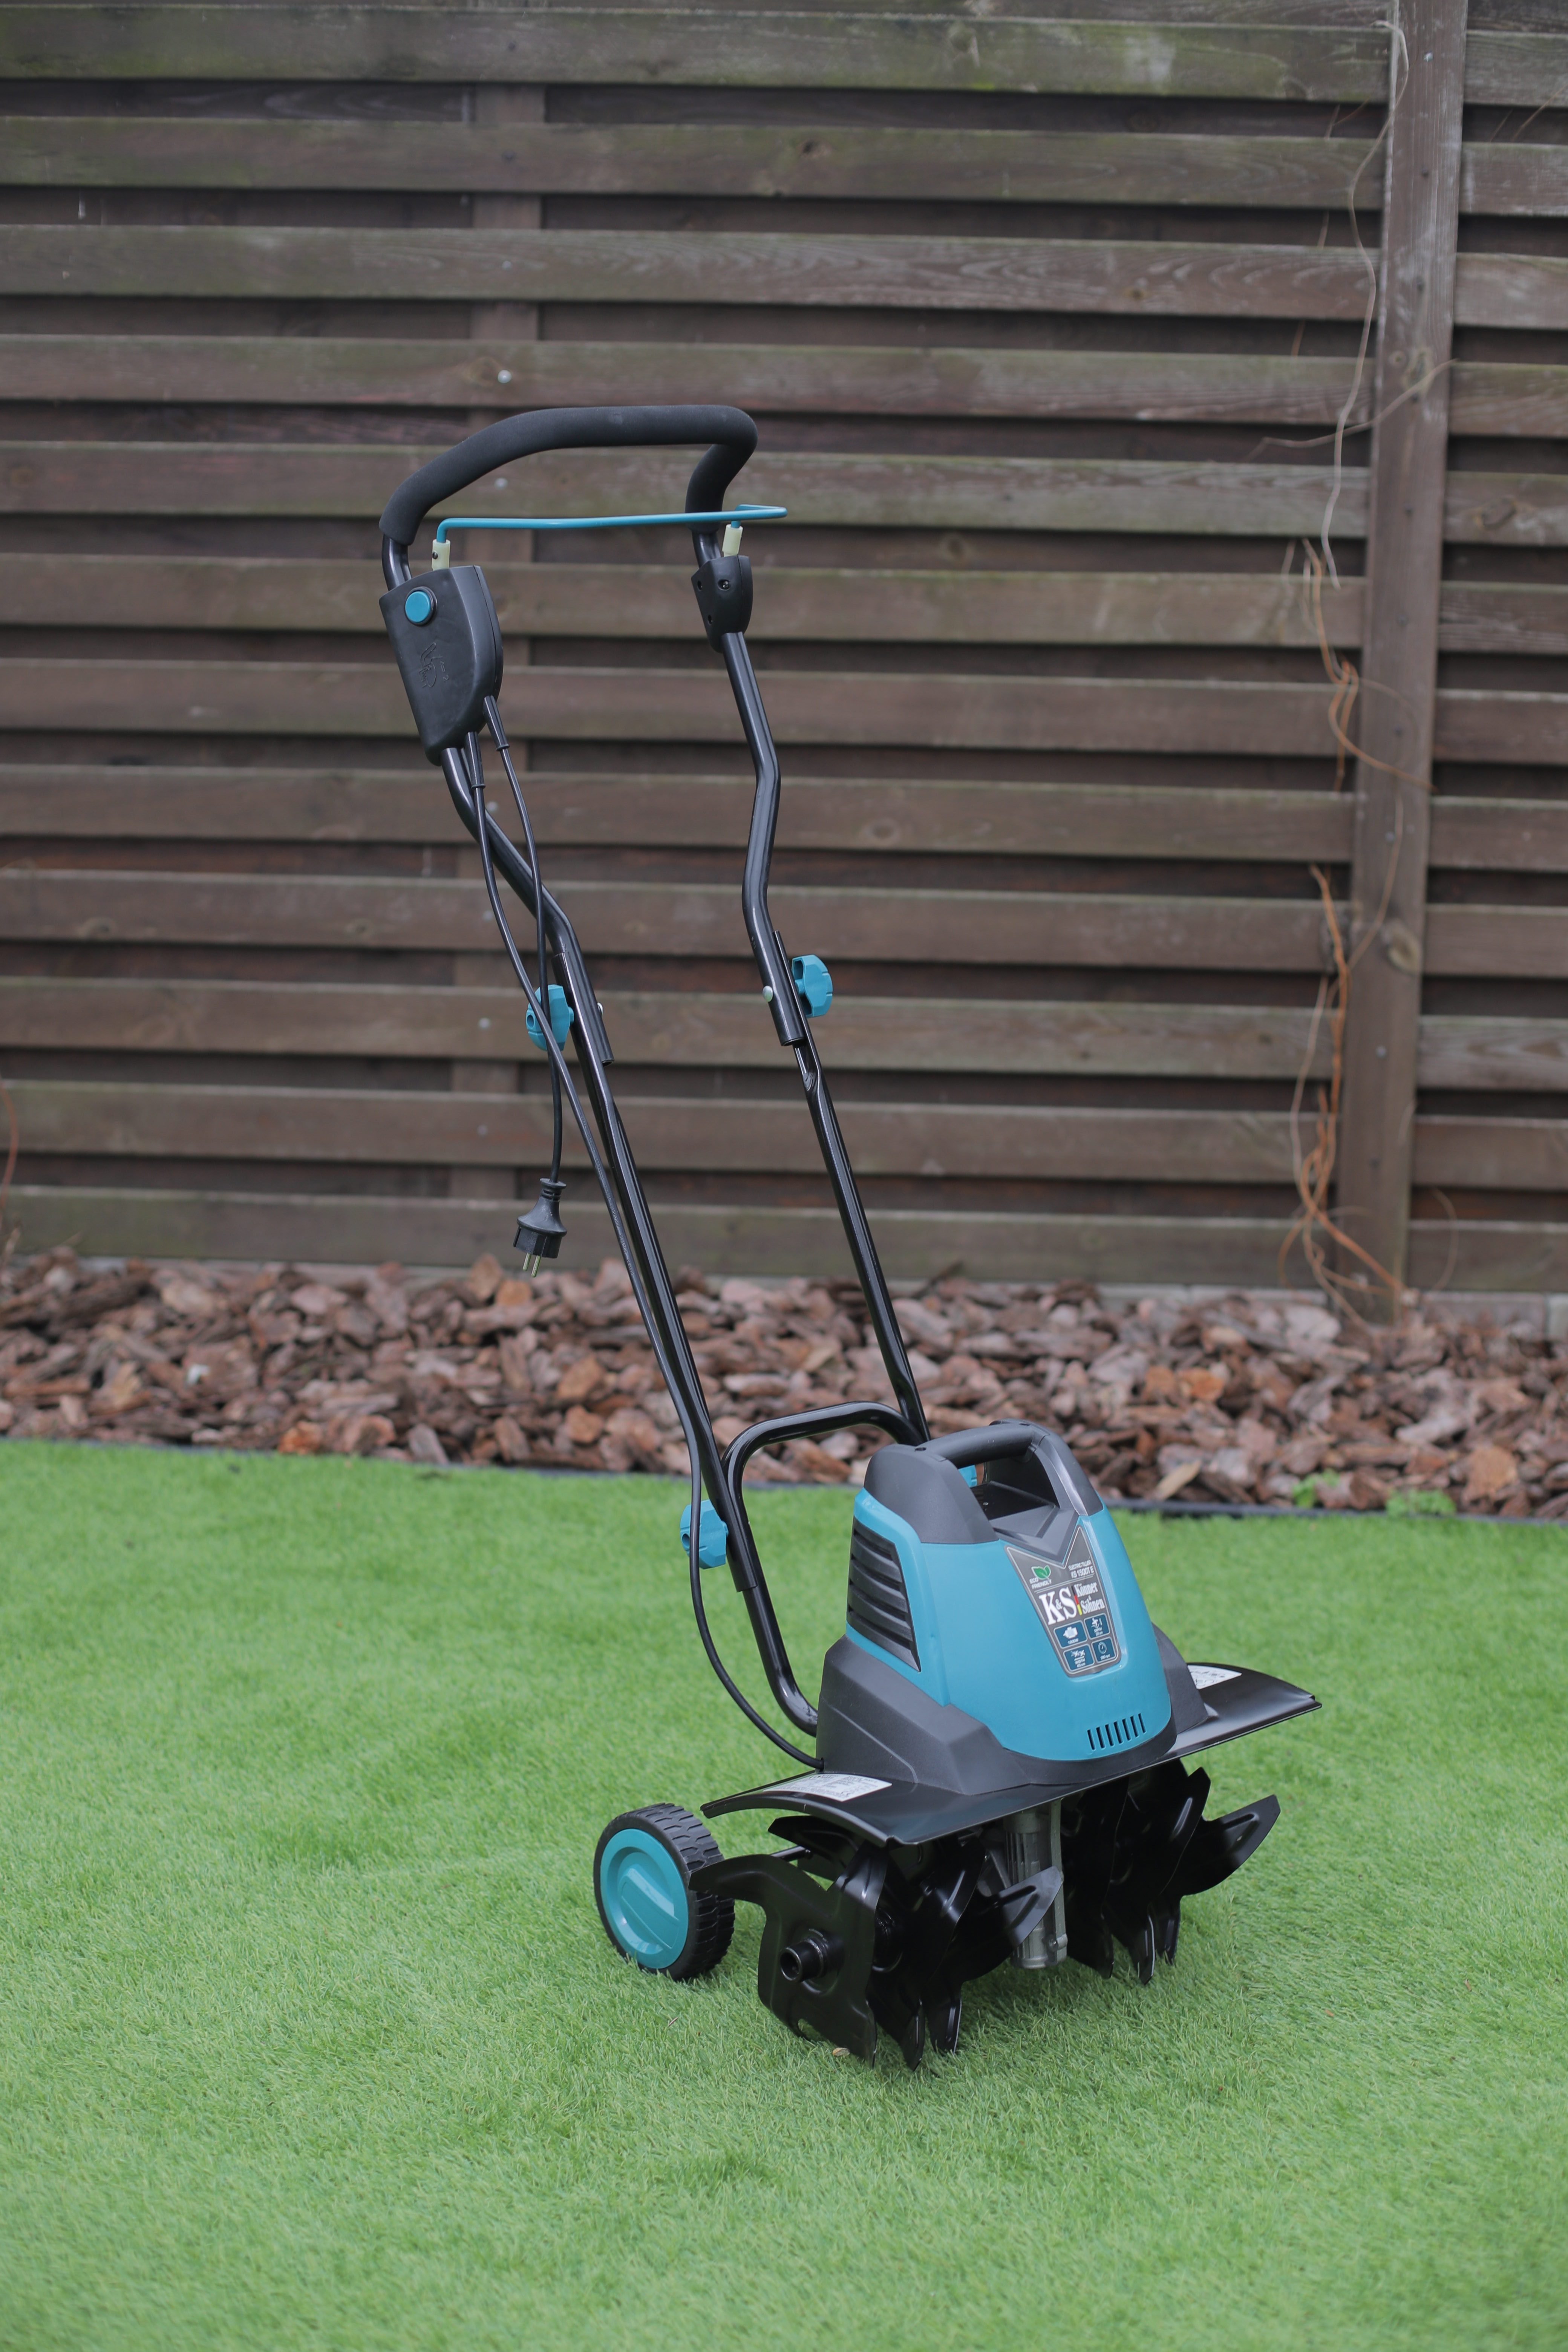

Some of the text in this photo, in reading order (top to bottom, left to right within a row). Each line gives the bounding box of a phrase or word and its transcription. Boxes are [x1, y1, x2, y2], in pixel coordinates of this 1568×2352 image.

[1070, 1570, 1077, 1579] KS
[1090, 1565, 1095, 1574] E
[1031, 1578, 1052, 1589] FRIENDLY
[1073, 1582, 1098, 1598] Könner
[1038, 1586, 1077, 1625] K&S
[1080, 1598, 1105, 1614] Söhnen
